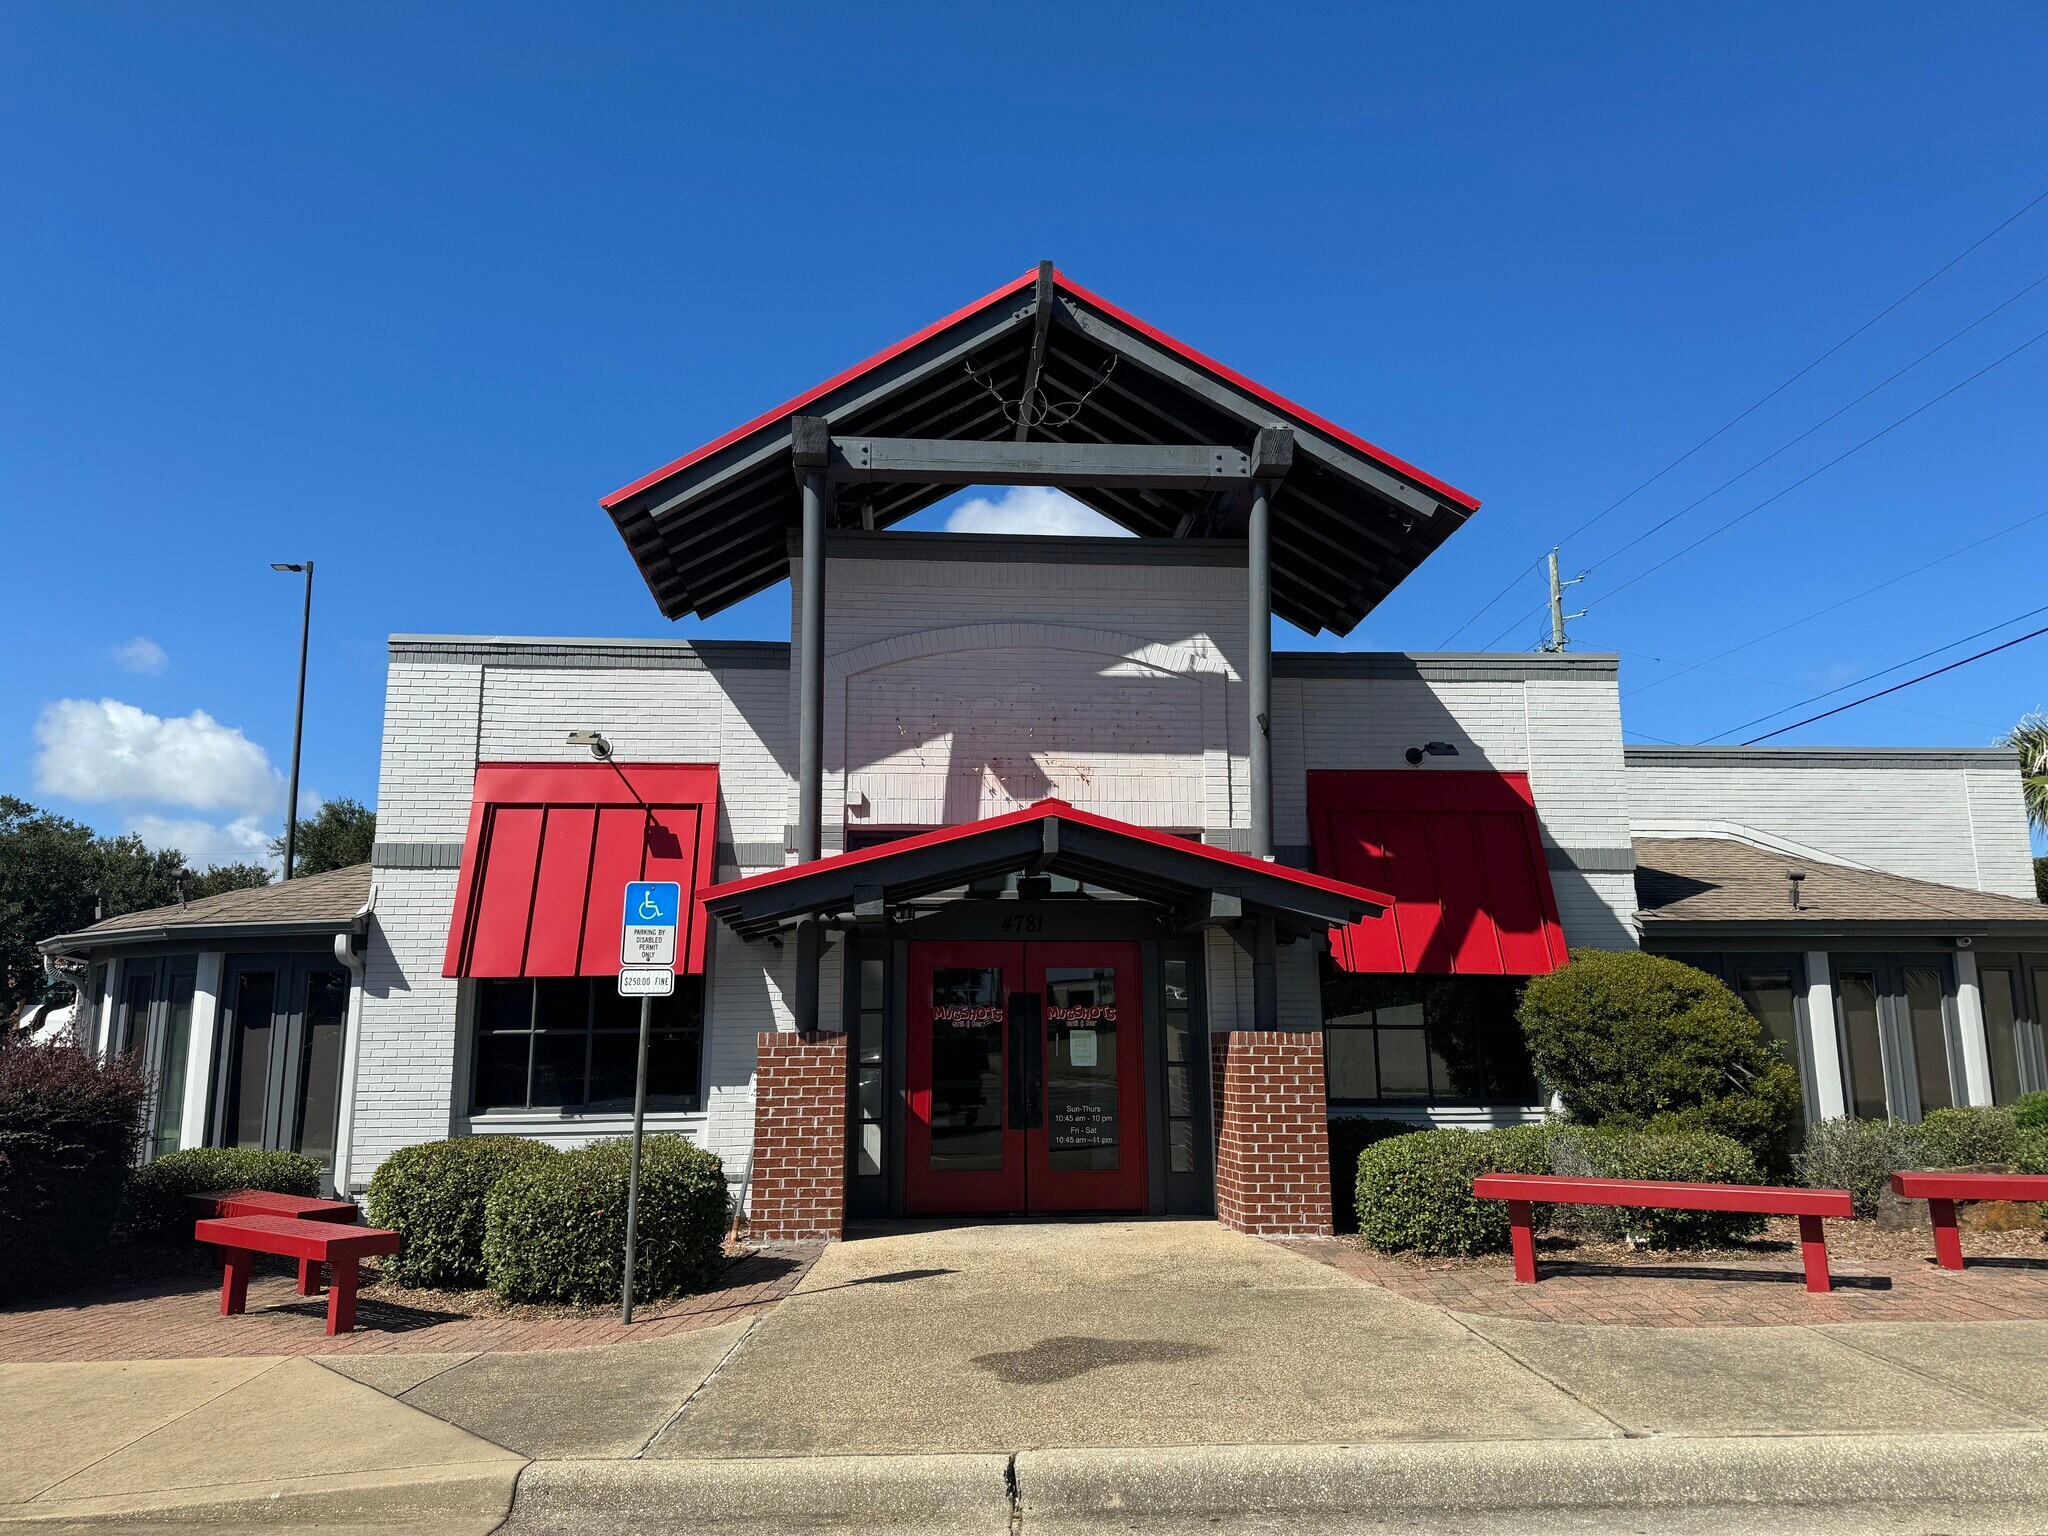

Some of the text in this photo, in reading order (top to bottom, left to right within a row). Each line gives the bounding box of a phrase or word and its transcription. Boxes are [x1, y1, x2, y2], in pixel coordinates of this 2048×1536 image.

[1001, 914, 1043, 933] 4781
[624, 977, 669, 987] $250.00 FINE
[1066, 1104, 1102, 1113] Sun-Thurs
[1055, 1114, 1074, 1122] 10:45
[1092, 1114, 1101, 1122] 10
[1101, 1116, 1113, 1124] pm
[1070, 1126, 1080, 1134] Fri
[1085, 1126, 1098, 1134] Sat
[1055, 1136, 1075, 1144] 10:45
[1092, 1136, 1101, 1144] 11
